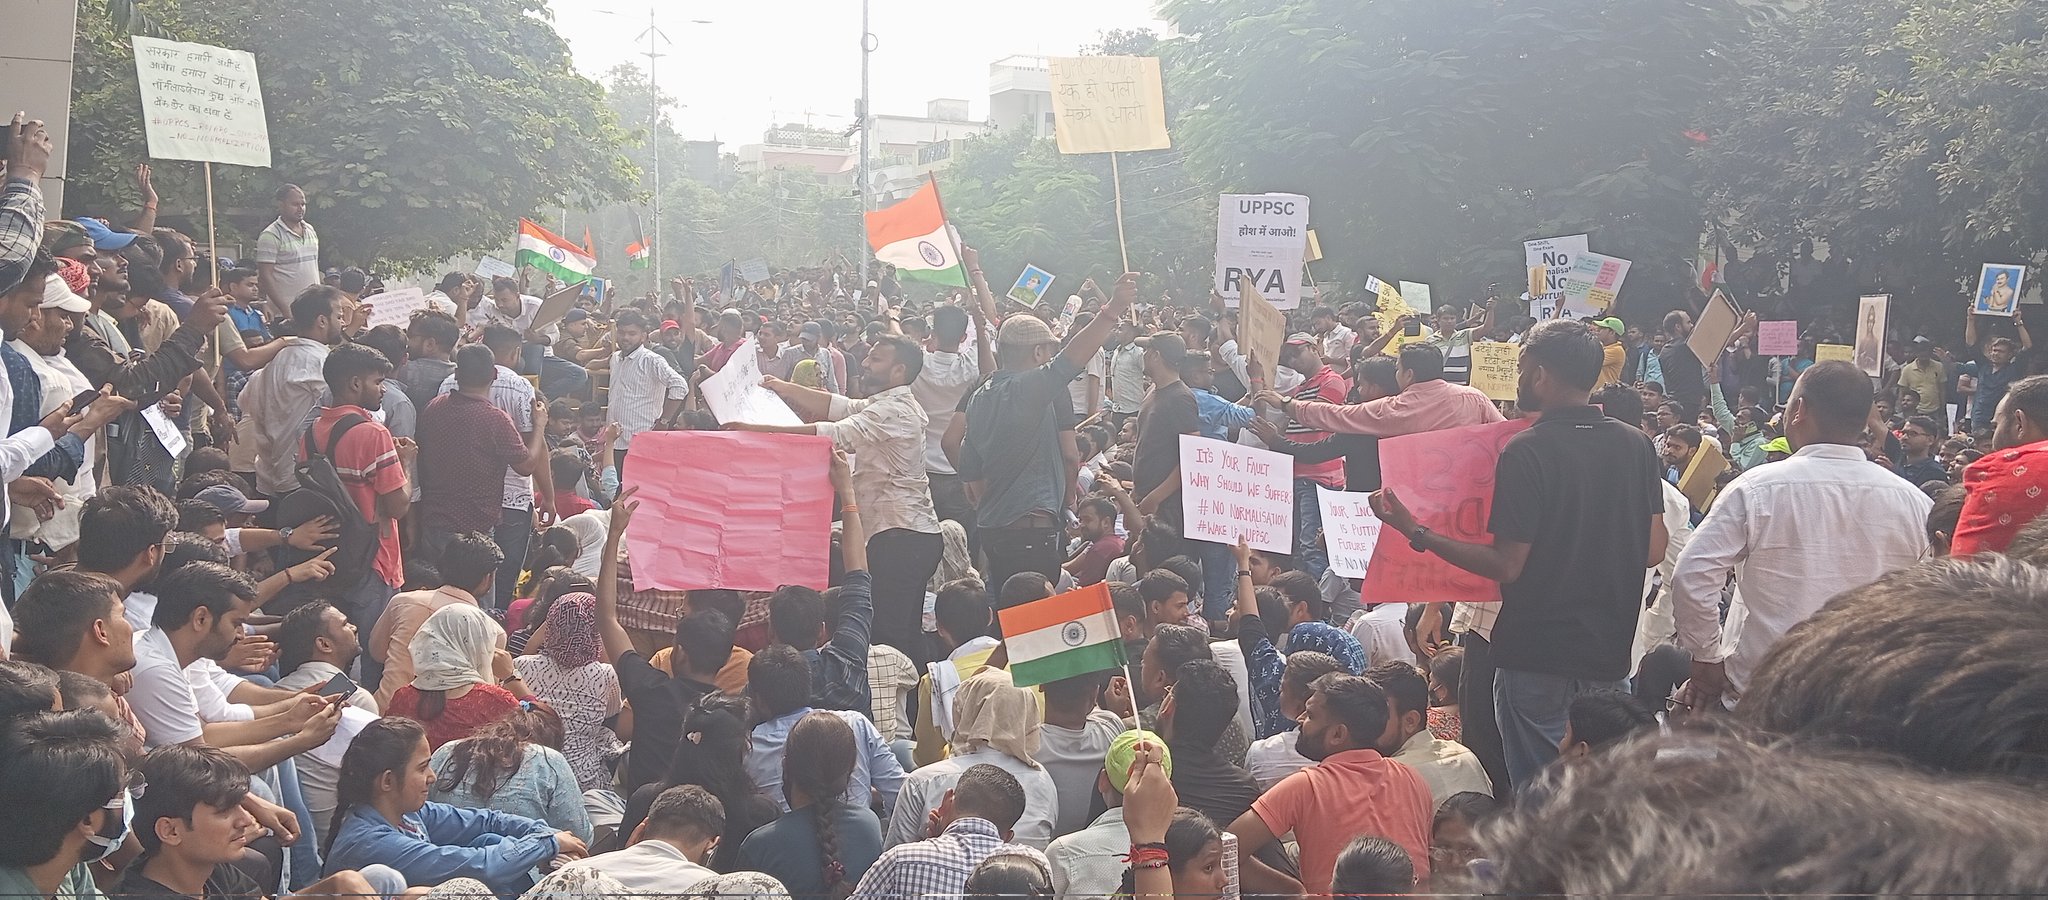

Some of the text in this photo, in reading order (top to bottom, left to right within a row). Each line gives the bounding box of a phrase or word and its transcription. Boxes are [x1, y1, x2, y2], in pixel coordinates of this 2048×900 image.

[145, 46, 180, 60] सरकार
[1239, 200, 1295, 215] UPPSC
[1238, 224, 1297, 237] होश में आओ!
[1543, 252, 1568, 267] No
[1223, 267, 1286, 294] RYA
[1195, 447, 1270, 477] IT'S YOUR FAULT
[1189, 471, 1210, 491] WHY
[1217, 474, 1243, 494] SHOULD
[1247, 482, 1261, 498] WE
[1198, 498, 1209, 516] #
[1212, 499, 1225, 515] NO
[1328, 501, 1374, 517] YOUR INC
[1196, 519, 1227, 536] #WAKE
[1245, 527, 1270, 545] UPPSC
[1339, 523, 1380, 537] IS PUTTIN
[1338, 537, 1367, 552] FUTURE
[1345, 557, 1358, 571] NO
